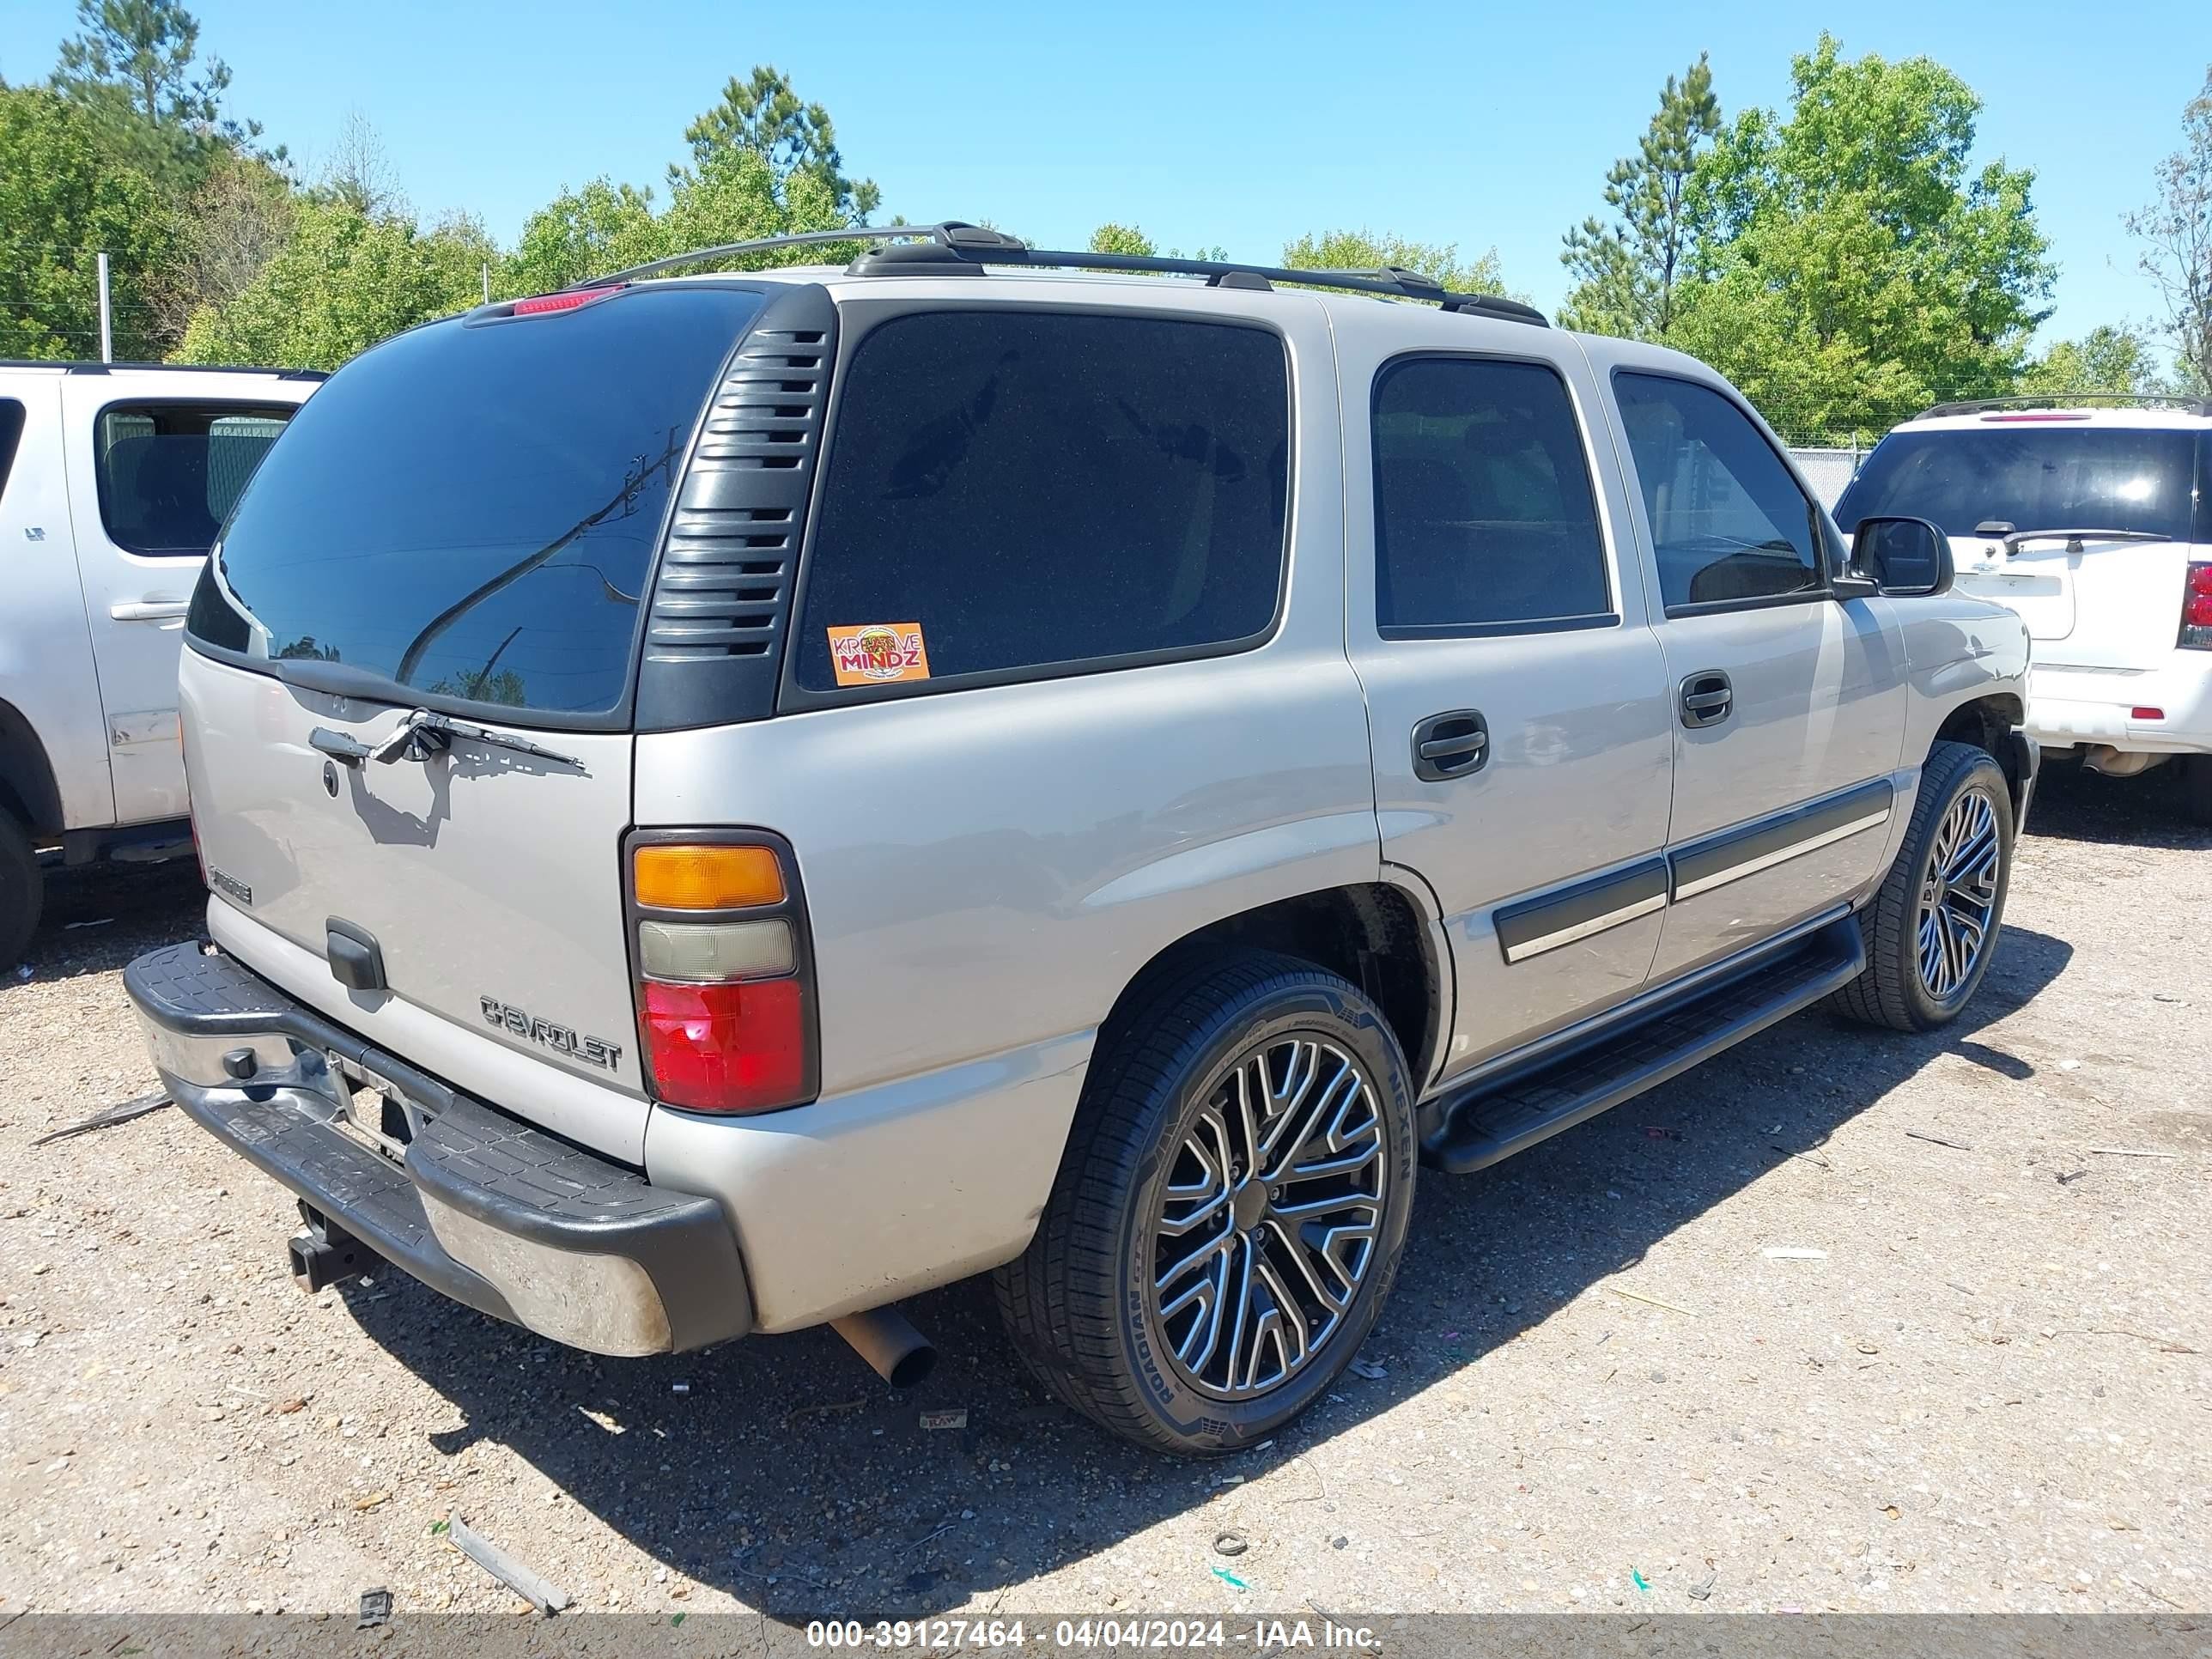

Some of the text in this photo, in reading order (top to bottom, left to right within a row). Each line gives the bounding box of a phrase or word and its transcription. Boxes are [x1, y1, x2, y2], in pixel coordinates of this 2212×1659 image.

[842, 651, 921, 671] MINDZ
[479, 994, 623, 1071] CHEVROLET
[1389, 1070, 1412, 1182] NEXEN
[1130, 1291, 1175, 1405] ROADIAN
[928, 1414, 958, 1428] RAW
